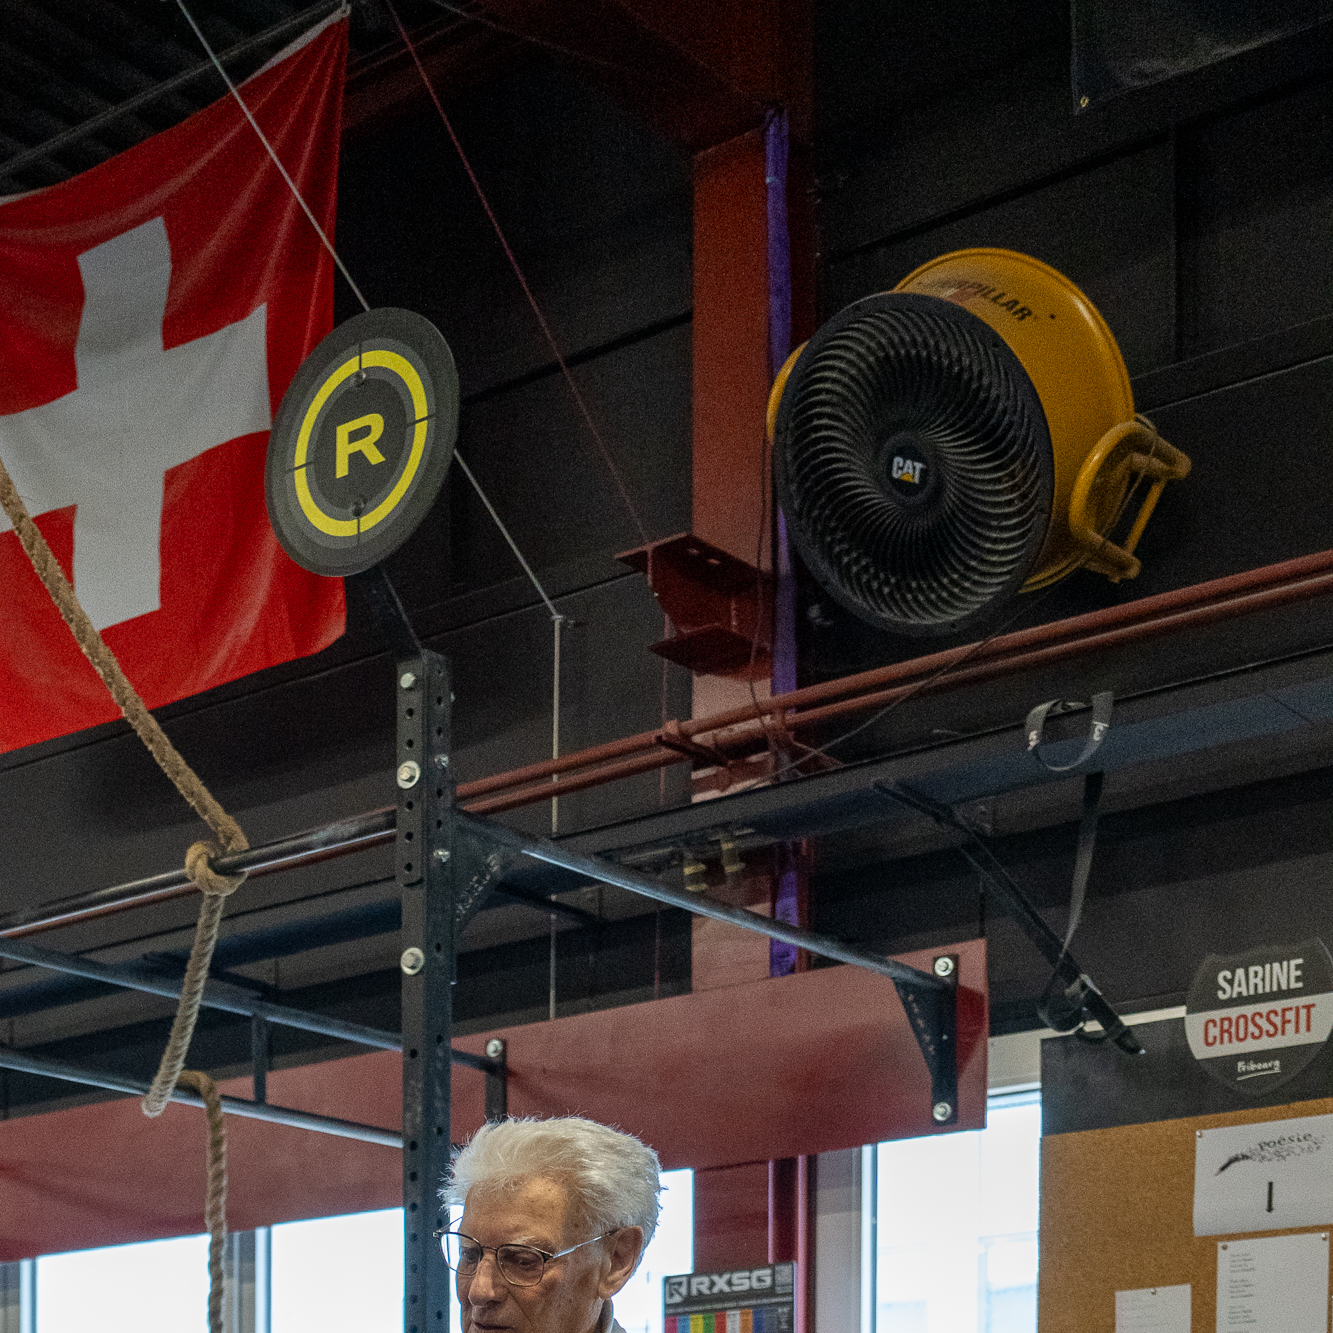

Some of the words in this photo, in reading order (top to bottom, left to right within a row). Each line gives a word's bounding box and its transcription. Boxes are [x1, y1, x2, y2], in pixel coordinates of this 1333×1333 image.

[335, 412, 386, 479] R
[892, 456, 927, 484] CAT
[1217, 957, 1305, 1000] SARINE
[1203, 1003, 1316, 1047] CROSSFIT
[690, 1268, 772, 1297] RXSG
